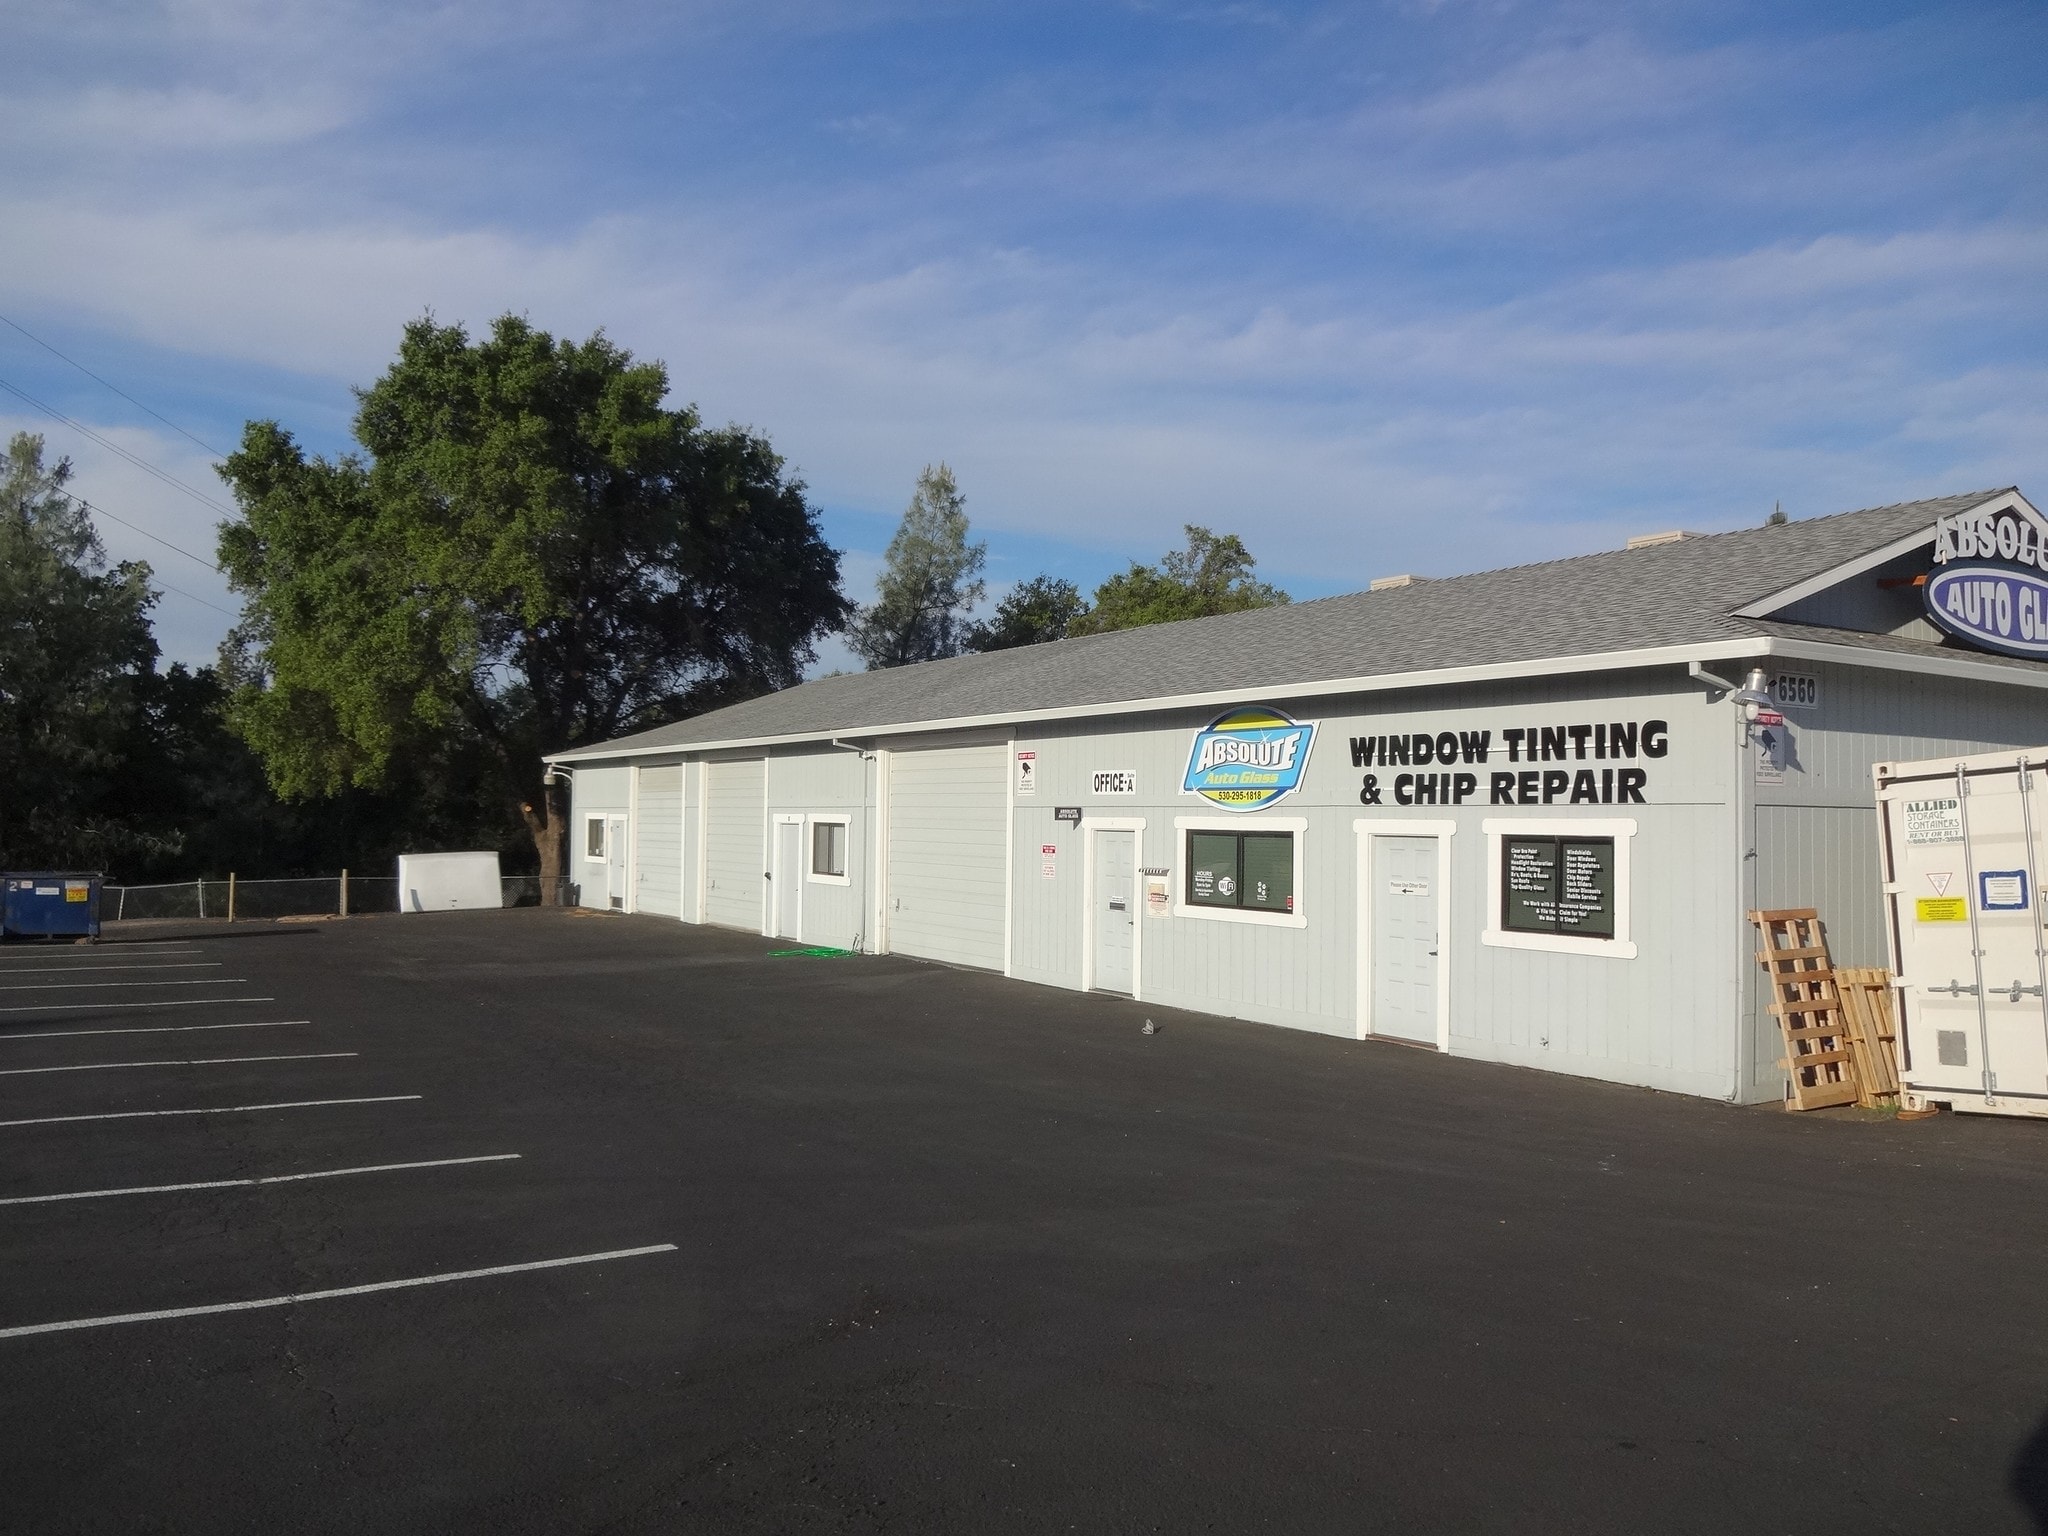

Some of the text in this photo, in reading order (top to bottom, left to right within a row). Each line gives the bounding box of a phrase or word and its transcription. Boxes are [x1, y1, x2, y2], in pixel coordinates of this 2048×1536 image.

[1946, 581, 2048, 640] AUTO GL
[1779, 675, 1816, 703] 6560
[1349, 720, 1668, 767] WINDOW TINTING
[1195, 731, 1302, 775] ABSOLUTE
[1093, 773, 1124, 792] OFFICE
[1204, 771, 1280, 785] Auto Glass
[1360, 768, 1647, 805] & CHIP REPAIR
[1218, 791, 1262, 801] 530-295-1818
[1906, 800, 1957, 813] ALLIED
[1908, 811, 1945, 821] STORAGE
[1908, 819, 1960, 830] CONTAINERS
[9, 881, 18, 892] 2
